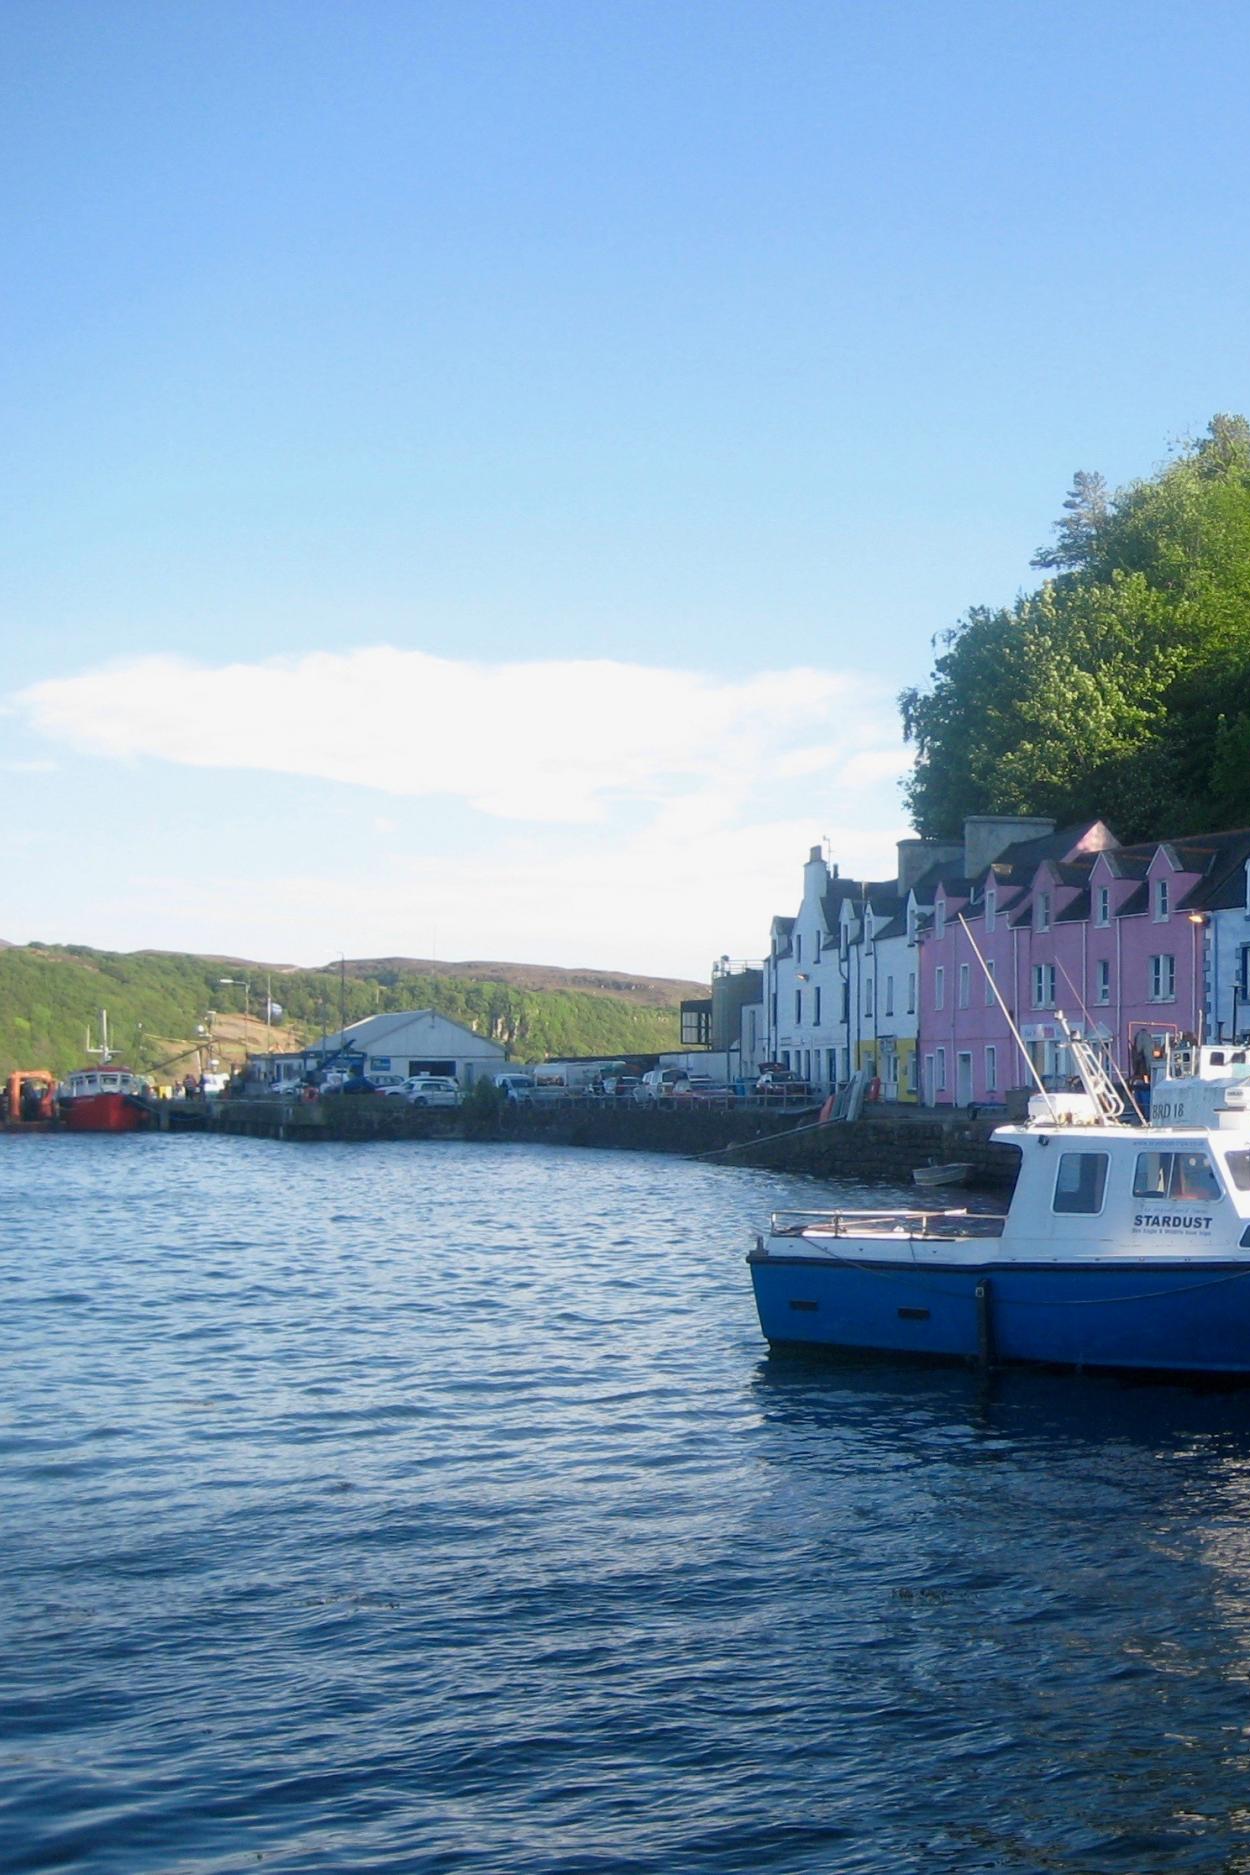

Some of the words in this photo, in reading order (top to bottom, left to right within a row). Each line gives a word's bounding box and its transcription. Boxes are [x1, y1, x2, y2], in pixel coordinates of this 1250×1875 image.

[1152, 1104, 1171, 1120] BRD
[1173, 1103, 1185, 1118] 18
[1134, 1215, 1213, 1229] STARDUST
